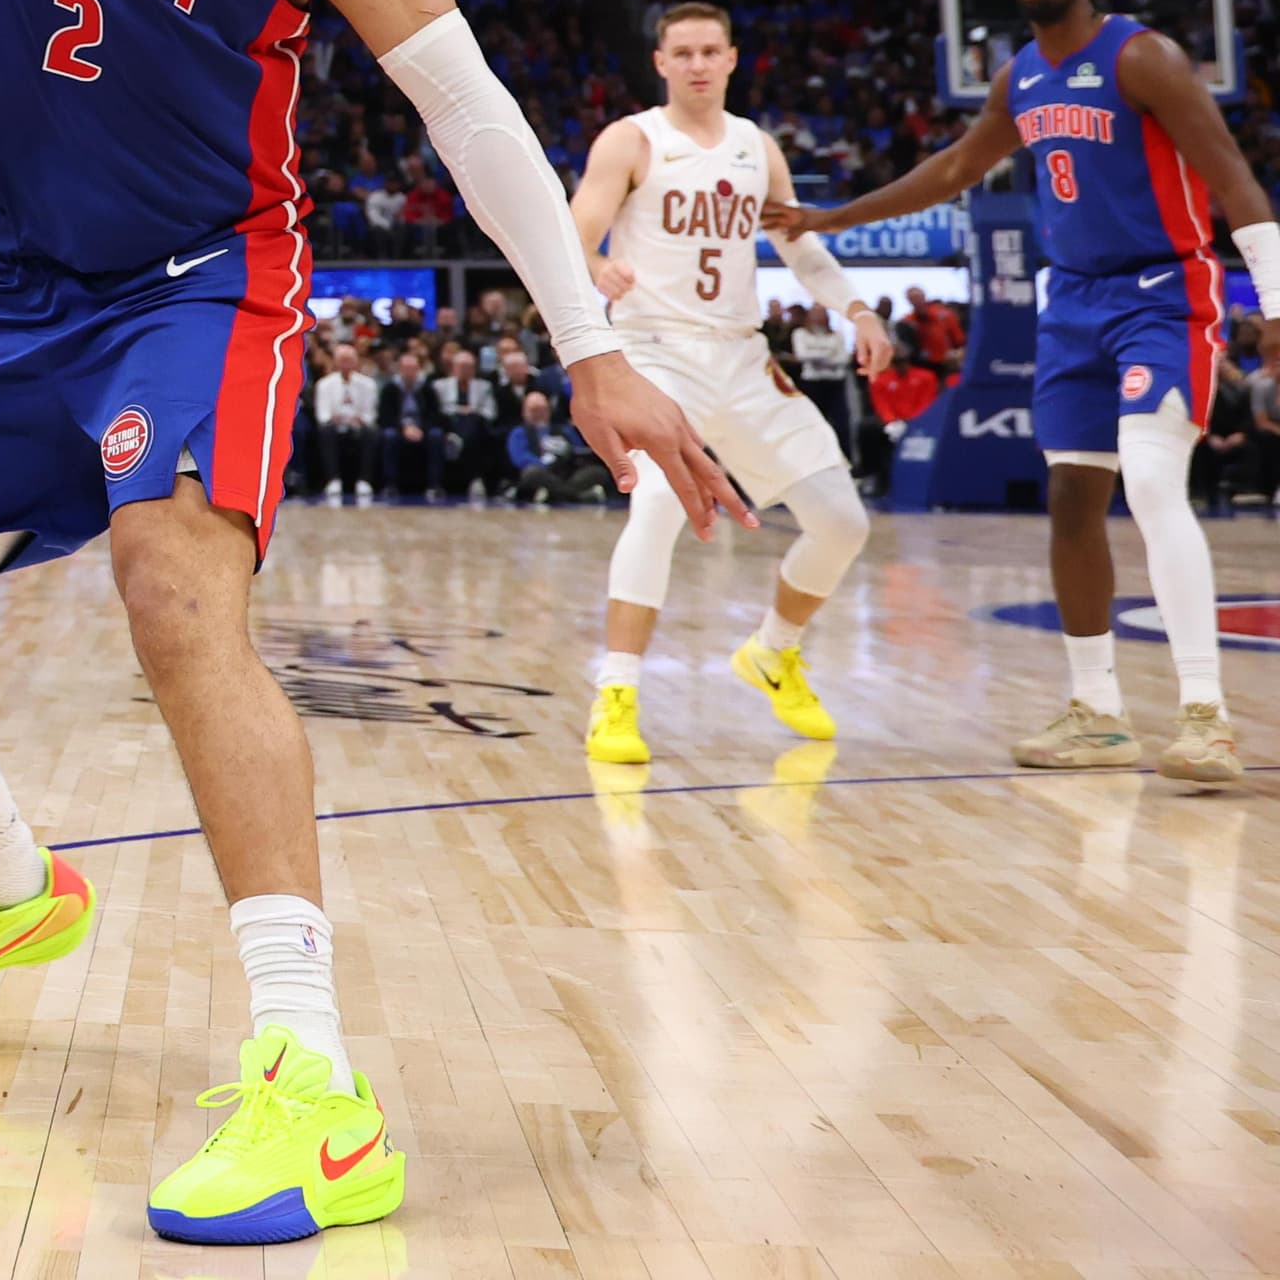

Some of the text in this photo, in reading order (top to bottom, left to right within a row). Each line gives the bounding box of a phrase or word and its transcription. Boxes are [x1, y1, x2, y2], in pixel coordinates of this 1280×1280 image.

[1014, 102, 1116, 147] DETROIT
[1045, 149, 1080, 204] 8
[661, 188, 758, 241] CAVS
[835, 229, 929, 258] CLUB
[694, 247, 723, 302] 5
[106, 436, 141, 458] PISTONS
[107, 424, 141, 447] DETROIT
